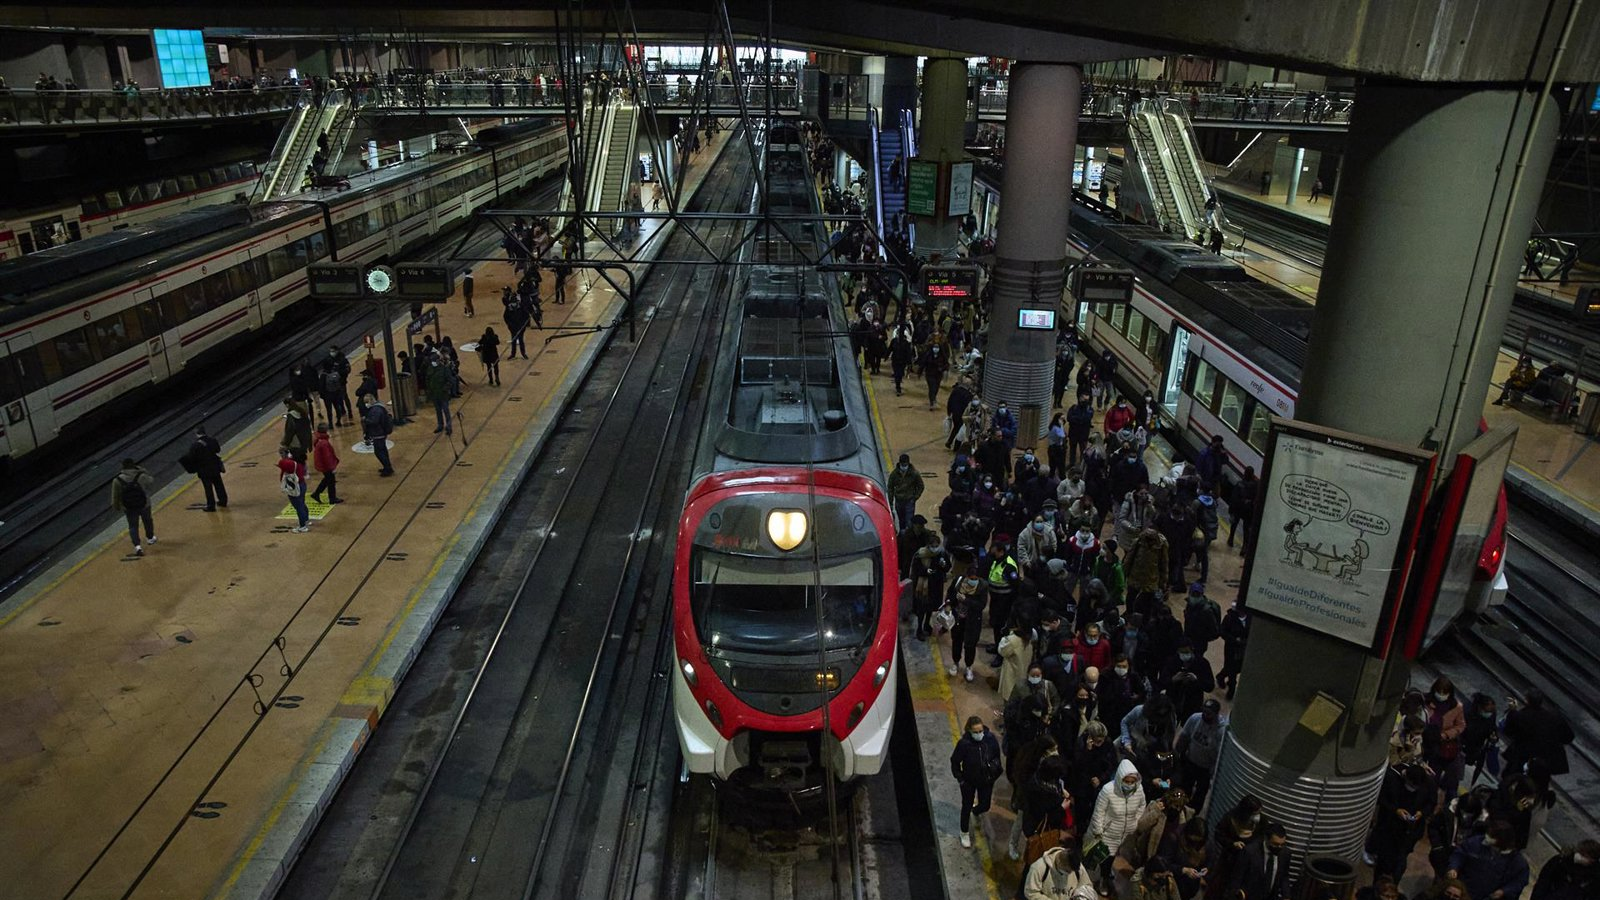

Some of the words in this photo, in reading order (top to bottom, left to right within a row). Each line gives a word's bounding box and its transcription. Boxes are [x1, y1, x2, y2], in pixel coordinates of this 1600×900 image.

[1250, 380, 1264, 394] renfe
[1258, 587, 1367, 628] #IgualdeProfesionales
[1268, 577, 1361, 613] #IgualdeDiferentes
